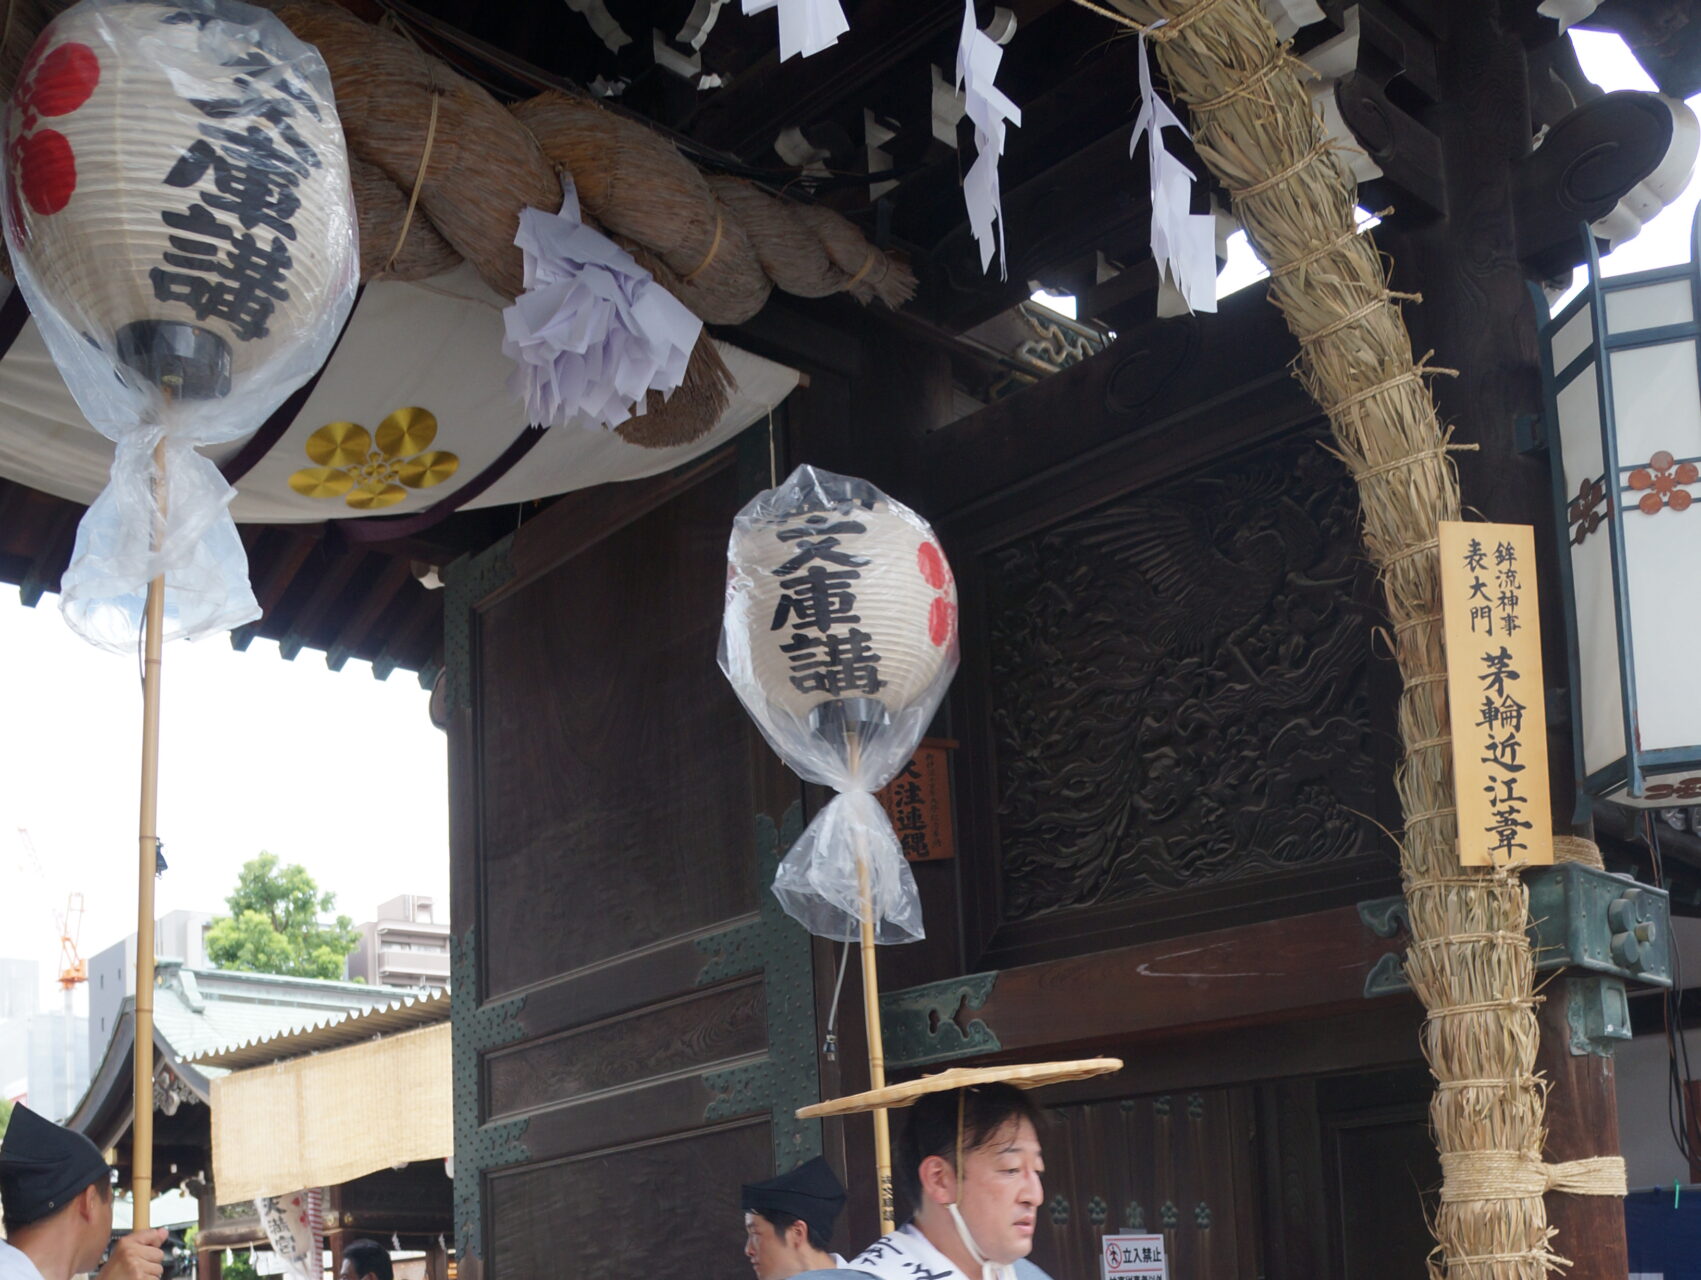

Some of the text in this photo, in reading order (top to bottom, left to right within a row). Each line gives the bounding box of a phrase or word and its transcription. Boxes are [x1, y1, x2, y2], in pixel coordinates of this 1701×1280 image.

[149, 50, 323, 342] 文庫講
[770, 514, 888, 697] 文庫講
[1462, 538, 1493, 637] 表大門
[1493, 541, 1522, 637] 鉾流神事
[1475, 646, 1533, 859] 茅輪近江葦
[1122, 1247, 1162, 1263] 立入禁止
